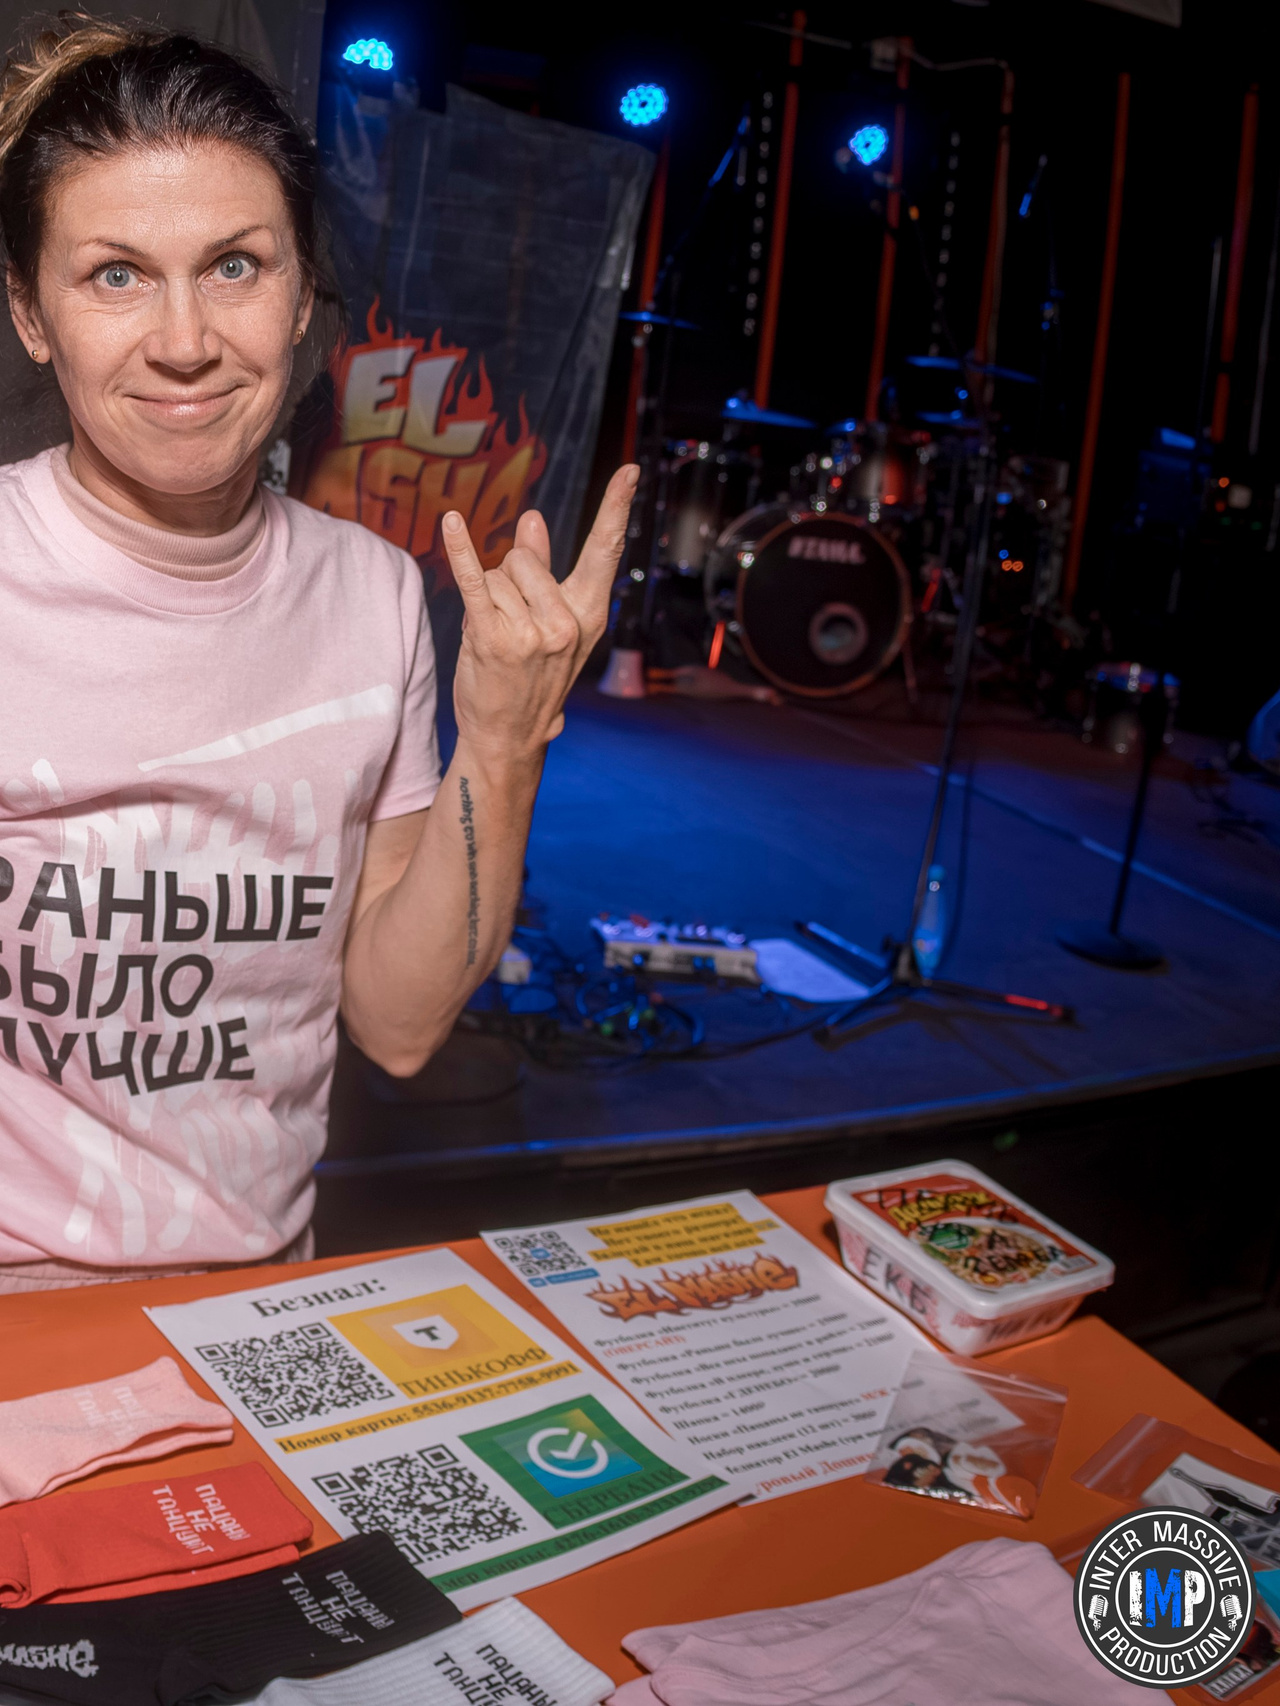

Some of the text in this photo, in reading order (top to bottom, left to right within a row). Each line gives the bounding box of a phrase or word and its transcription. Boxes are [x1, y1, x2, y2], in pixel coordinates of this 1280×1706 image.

[341, 346, 488, 458] EL
[459, 776, 474, 825] nothing
[249, 1279, 387, 1318] Безнал:
[592, 1328, 657, 1349] Футболка
[396, 1347, 548, 1397] ТИНЬКОФФ
[614, 1351, 681, 1374] Футболка
[628, 1364, 694, 1388] Футболка
[642, 1378, 708, 1402] Футболка
[656, 1392, 723, 1417] Футболка
[276, 1430, 342, 1453] Номер
[347, 1413, 411, 1437] карты:
[671, 1411, 722, 1432] Шапка
[686, 1427, 731, 1446] Носки
[727, 1412, 791, 1437] «Пацаны
[787, 1410, 807, 1420] не
[701, 1443, 747, 1464] Набор
[743, 1430, 799, 1452] наклеек
[195, 1484, 251, 1541] ПАЦАНЫ
[543, 1468, 684, 1523] СБЕРБАНК
[152, 1484, 214, 1555] ТАНЦУЮТ
[186, 1509, 216, 1533] НЕ
[320, 1594, 359, 1622] НЕ
[325, 1569, 395, 1631] ПАЦАНЫ
[475, 1644, 558, 1706] ПАЦАНЫ
[477, 1673, 516, 1701] НЕ
